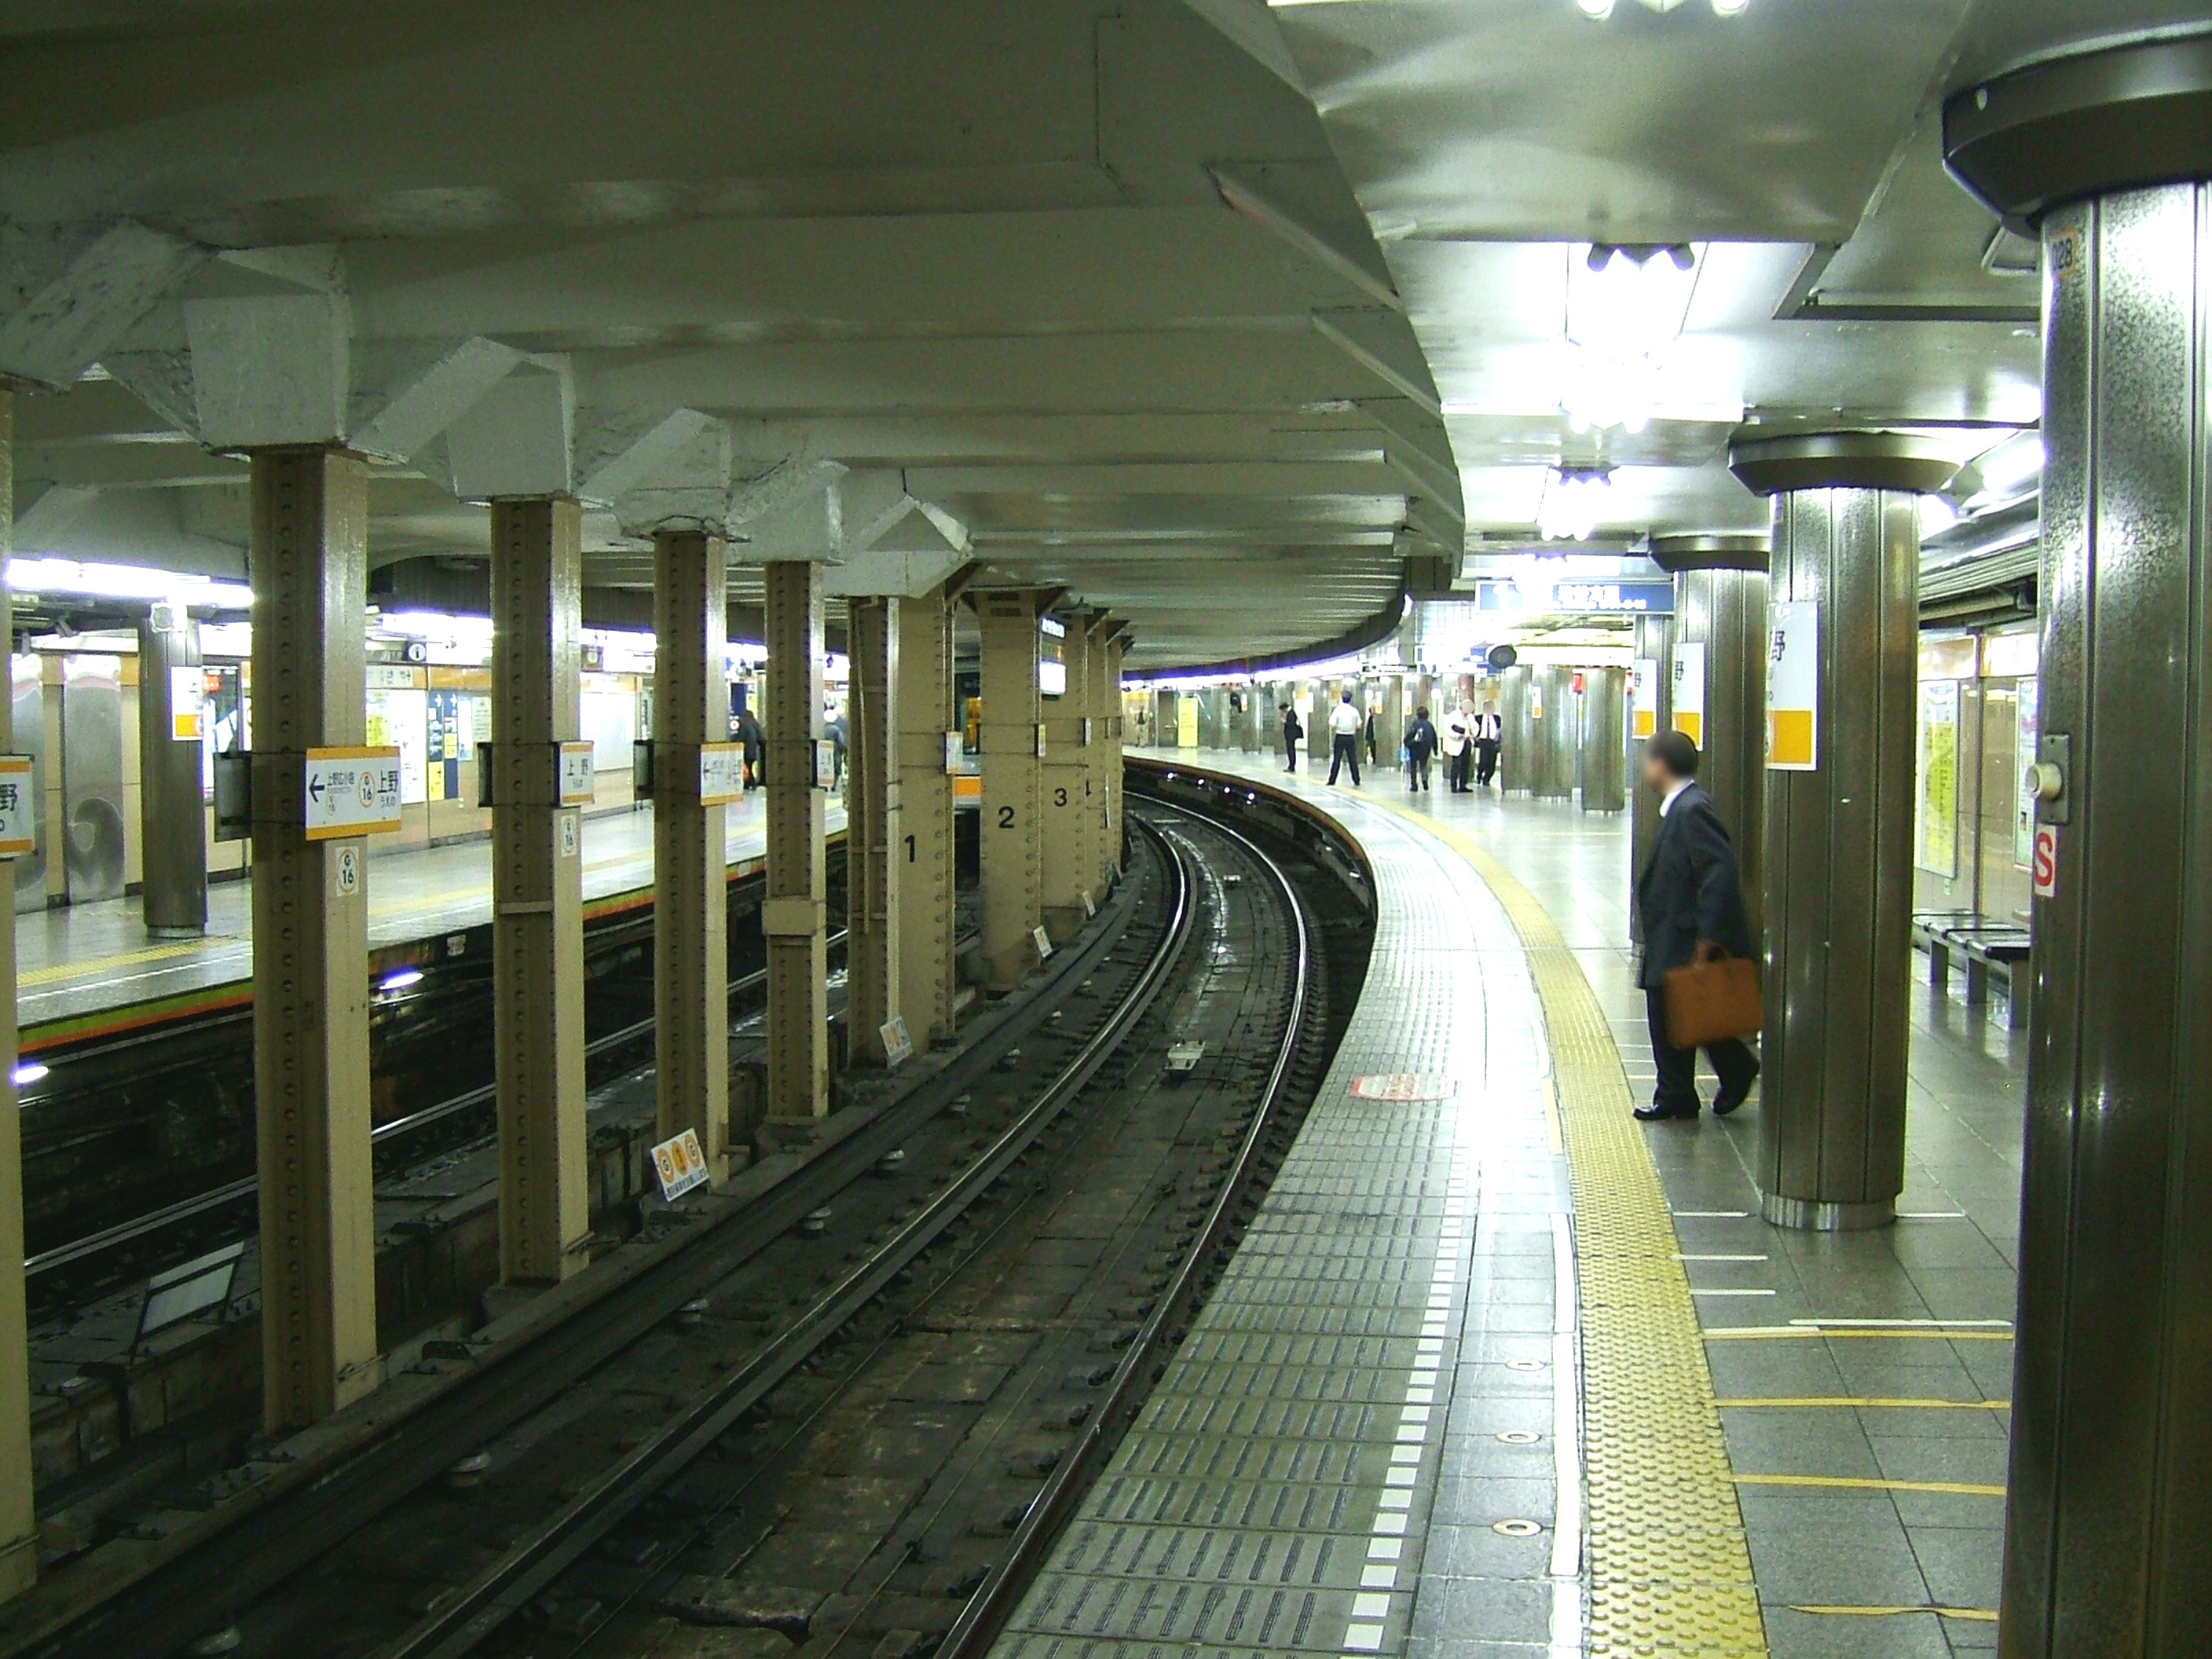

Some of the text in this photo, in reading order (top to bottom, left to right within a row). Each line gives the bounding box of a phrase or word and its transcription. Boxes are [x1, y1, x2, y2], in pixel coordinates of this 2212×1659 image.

[377, 770, 398, 793] 上野
[363, 788, 372, 800] 16
[1053, 787, 1068, 807] 3
[998, 805, 1015, 829] 2
[904, 834, 915, 862] 1
[344, 854, 351, 866] G
[2034, 831, 2053, 887] S
[342, 869, 354, 884] 16
